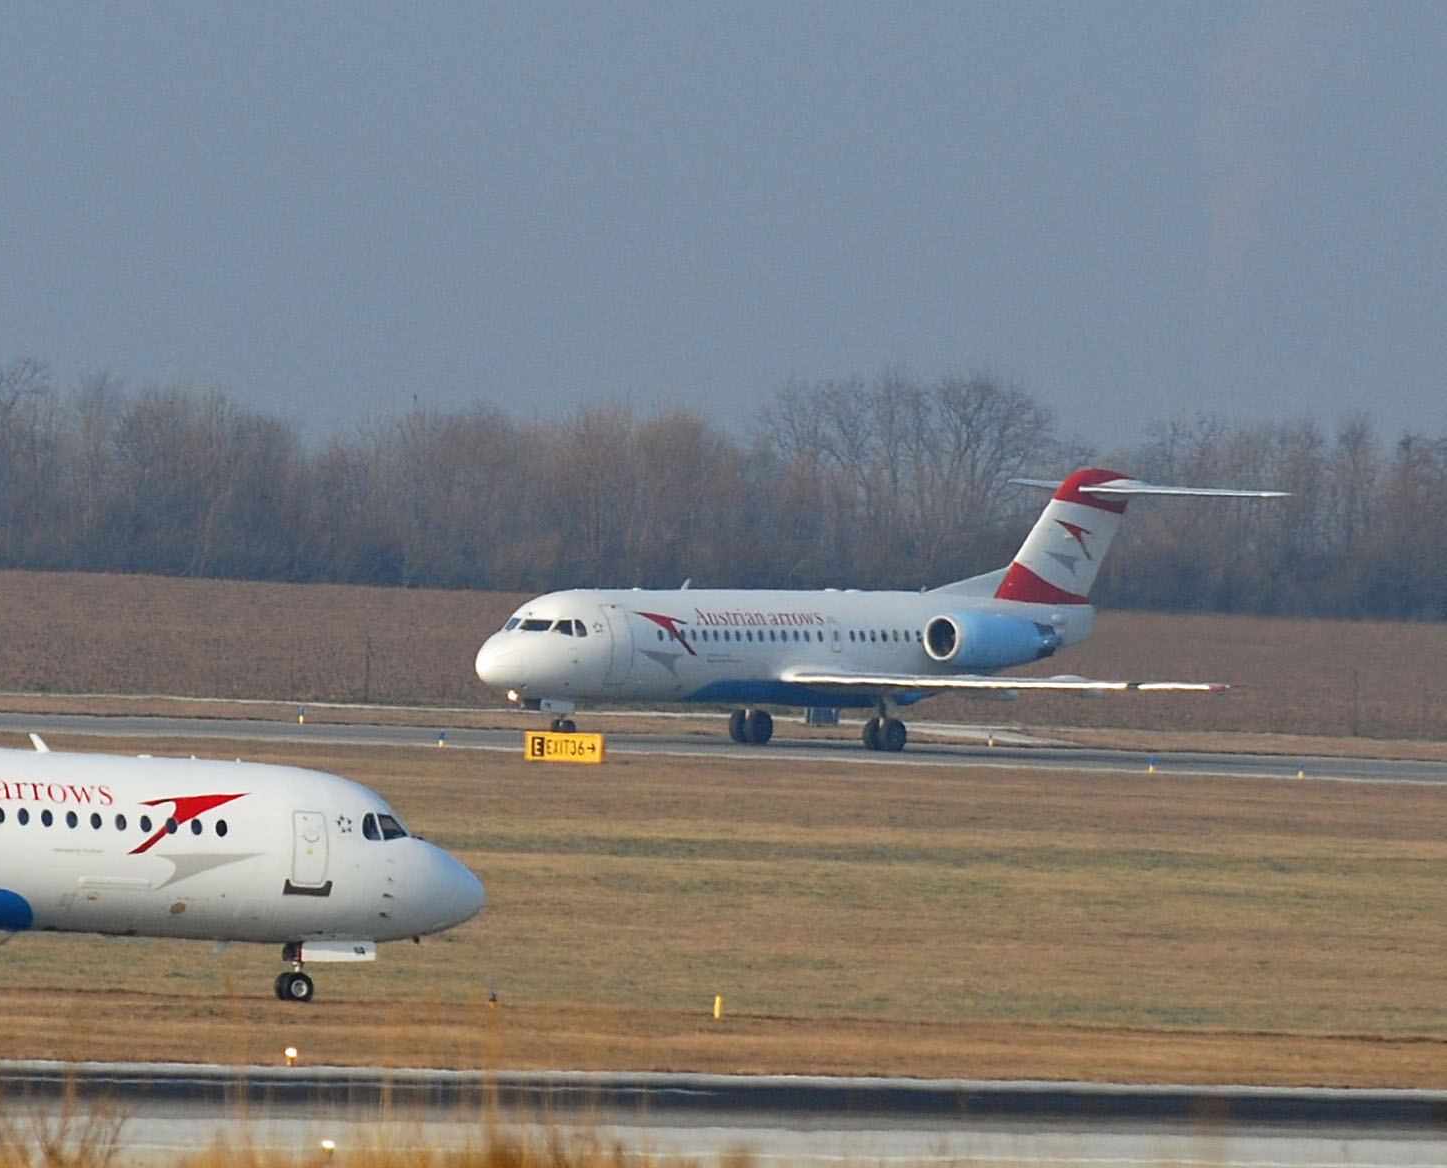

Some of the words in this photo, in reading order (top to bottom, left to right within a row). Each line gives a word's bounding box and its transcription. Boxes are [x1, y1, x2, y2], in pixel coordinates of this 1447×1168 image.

[695, 607, 767, 627] Austrian
[767, 612, 825, 627] arrows
[533, 737, 544, 757] E
